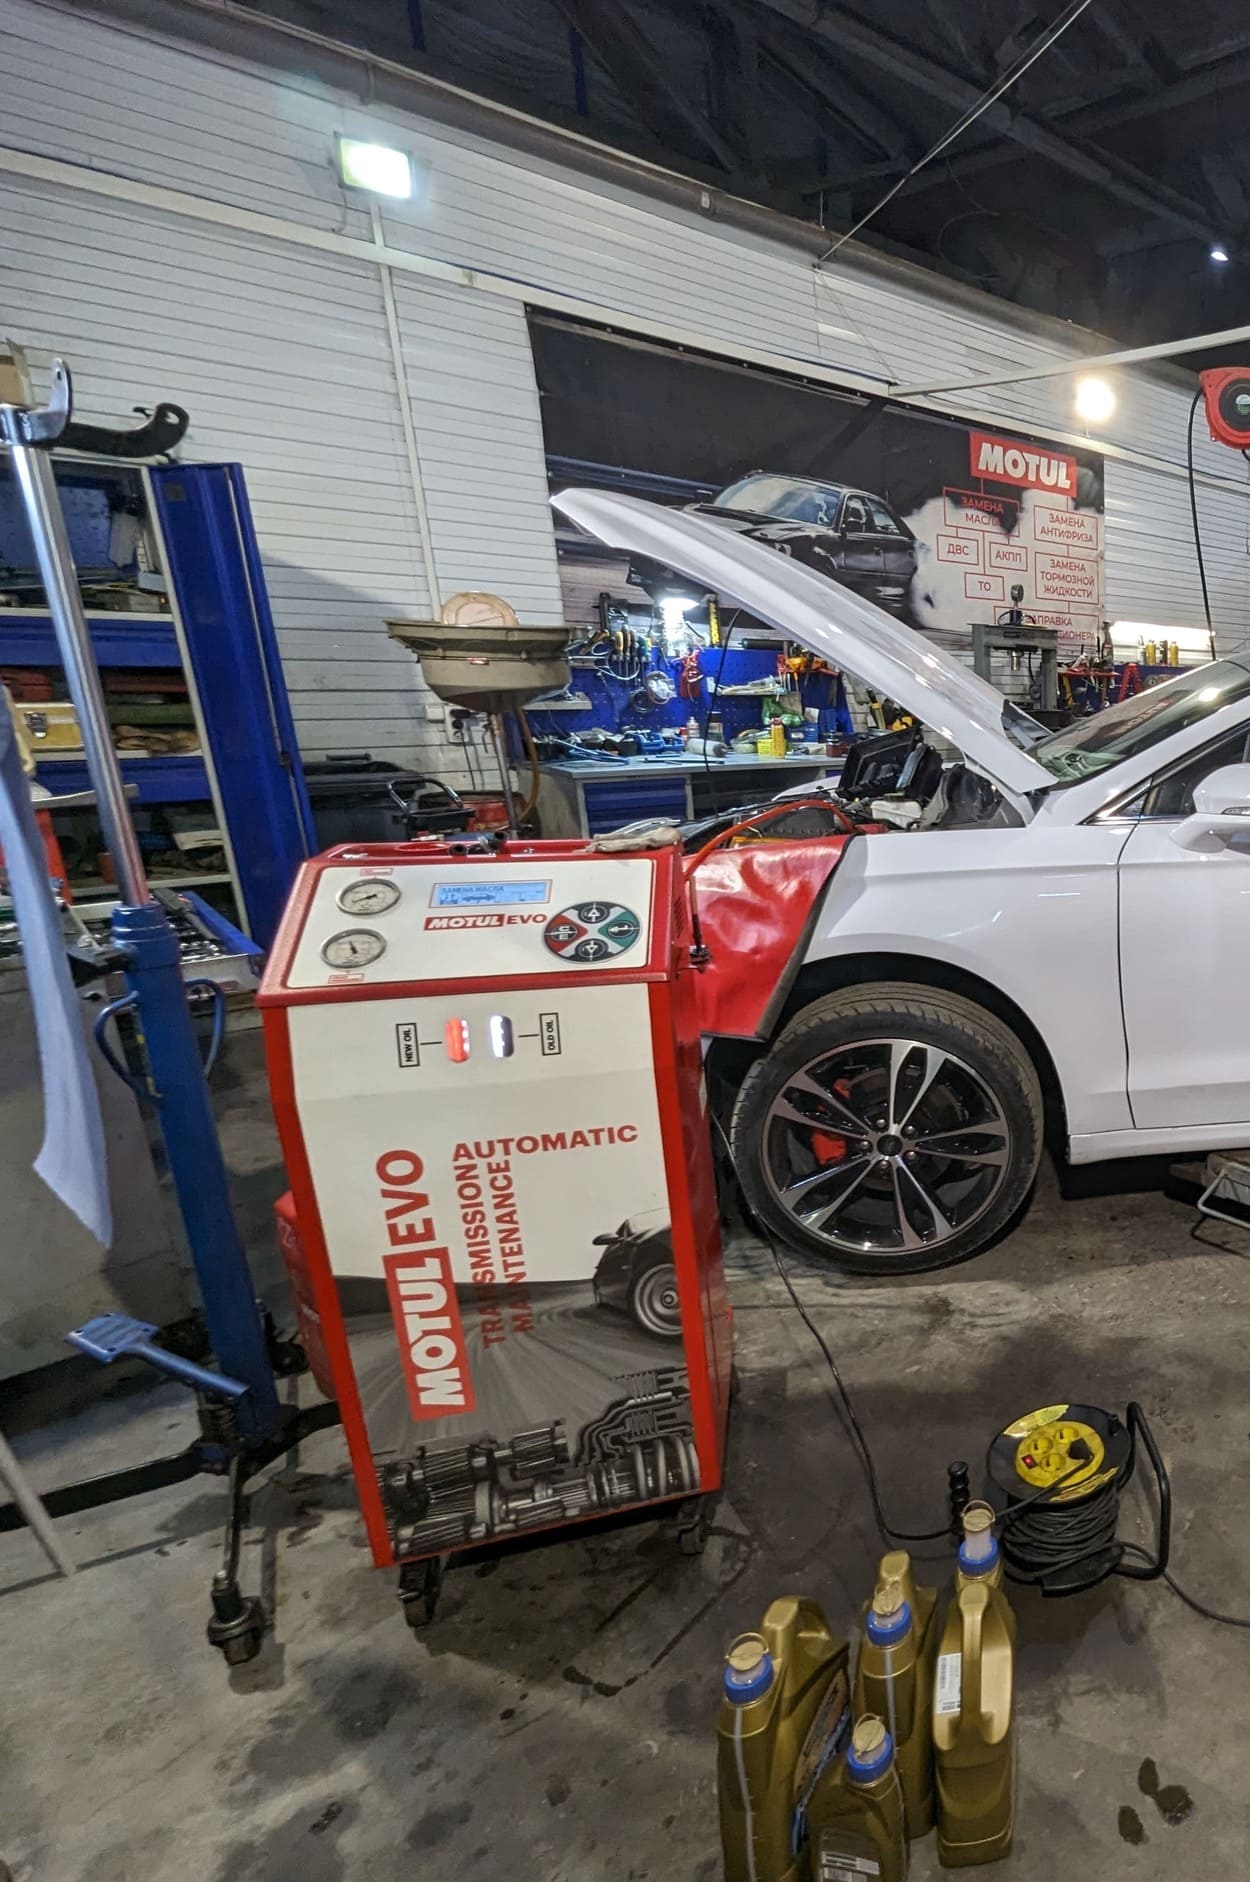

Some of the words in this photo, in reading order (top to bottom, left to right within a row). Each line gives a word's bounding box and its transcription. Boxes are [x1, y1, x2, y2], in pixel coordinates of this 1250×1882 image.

[978, 442, 1071, 489] MOTUL
[961, 496, 1004, 513] ЗАМЕНА
[1049, 513, 1086, 529] ЗАМЕНА
[1040, 526, 1094, 543] АНТИФРИЗА
[947, 543, 969, 556] ДВС
[995, 550, 1022, 563] АКПП
[1050, 559, 1086, 572] ЗАМЕНА
[978, 580, 991, 592] ТО
[1040, 571, 1095, 587] ТОРМОЗНОЙ
[1043, 585, 1093, 599] ЖИДКОСТИ
[1026, 614, 1073, 626] ЗАПРАВКА
[428, 915, 501, 929] MOTUL
[506, 914, 547, 925] EVO
[546, 1020, 554, 1033] OIL
[403, 1028, 412, 1042] OIL
[547, 1036, 555, 1051] OLD
[405, 1043, 413, 1062] NEW
[452, 1125, 638, 1162] AUTOMATIC
[376, 1149, 436, 1246] EVO
[487, 1160, 534, 1333] MAINTENANCE
[453, 1163, 505, 1349] TRANSMISSION
[395, 1257, 465, 1406] MOTUL
